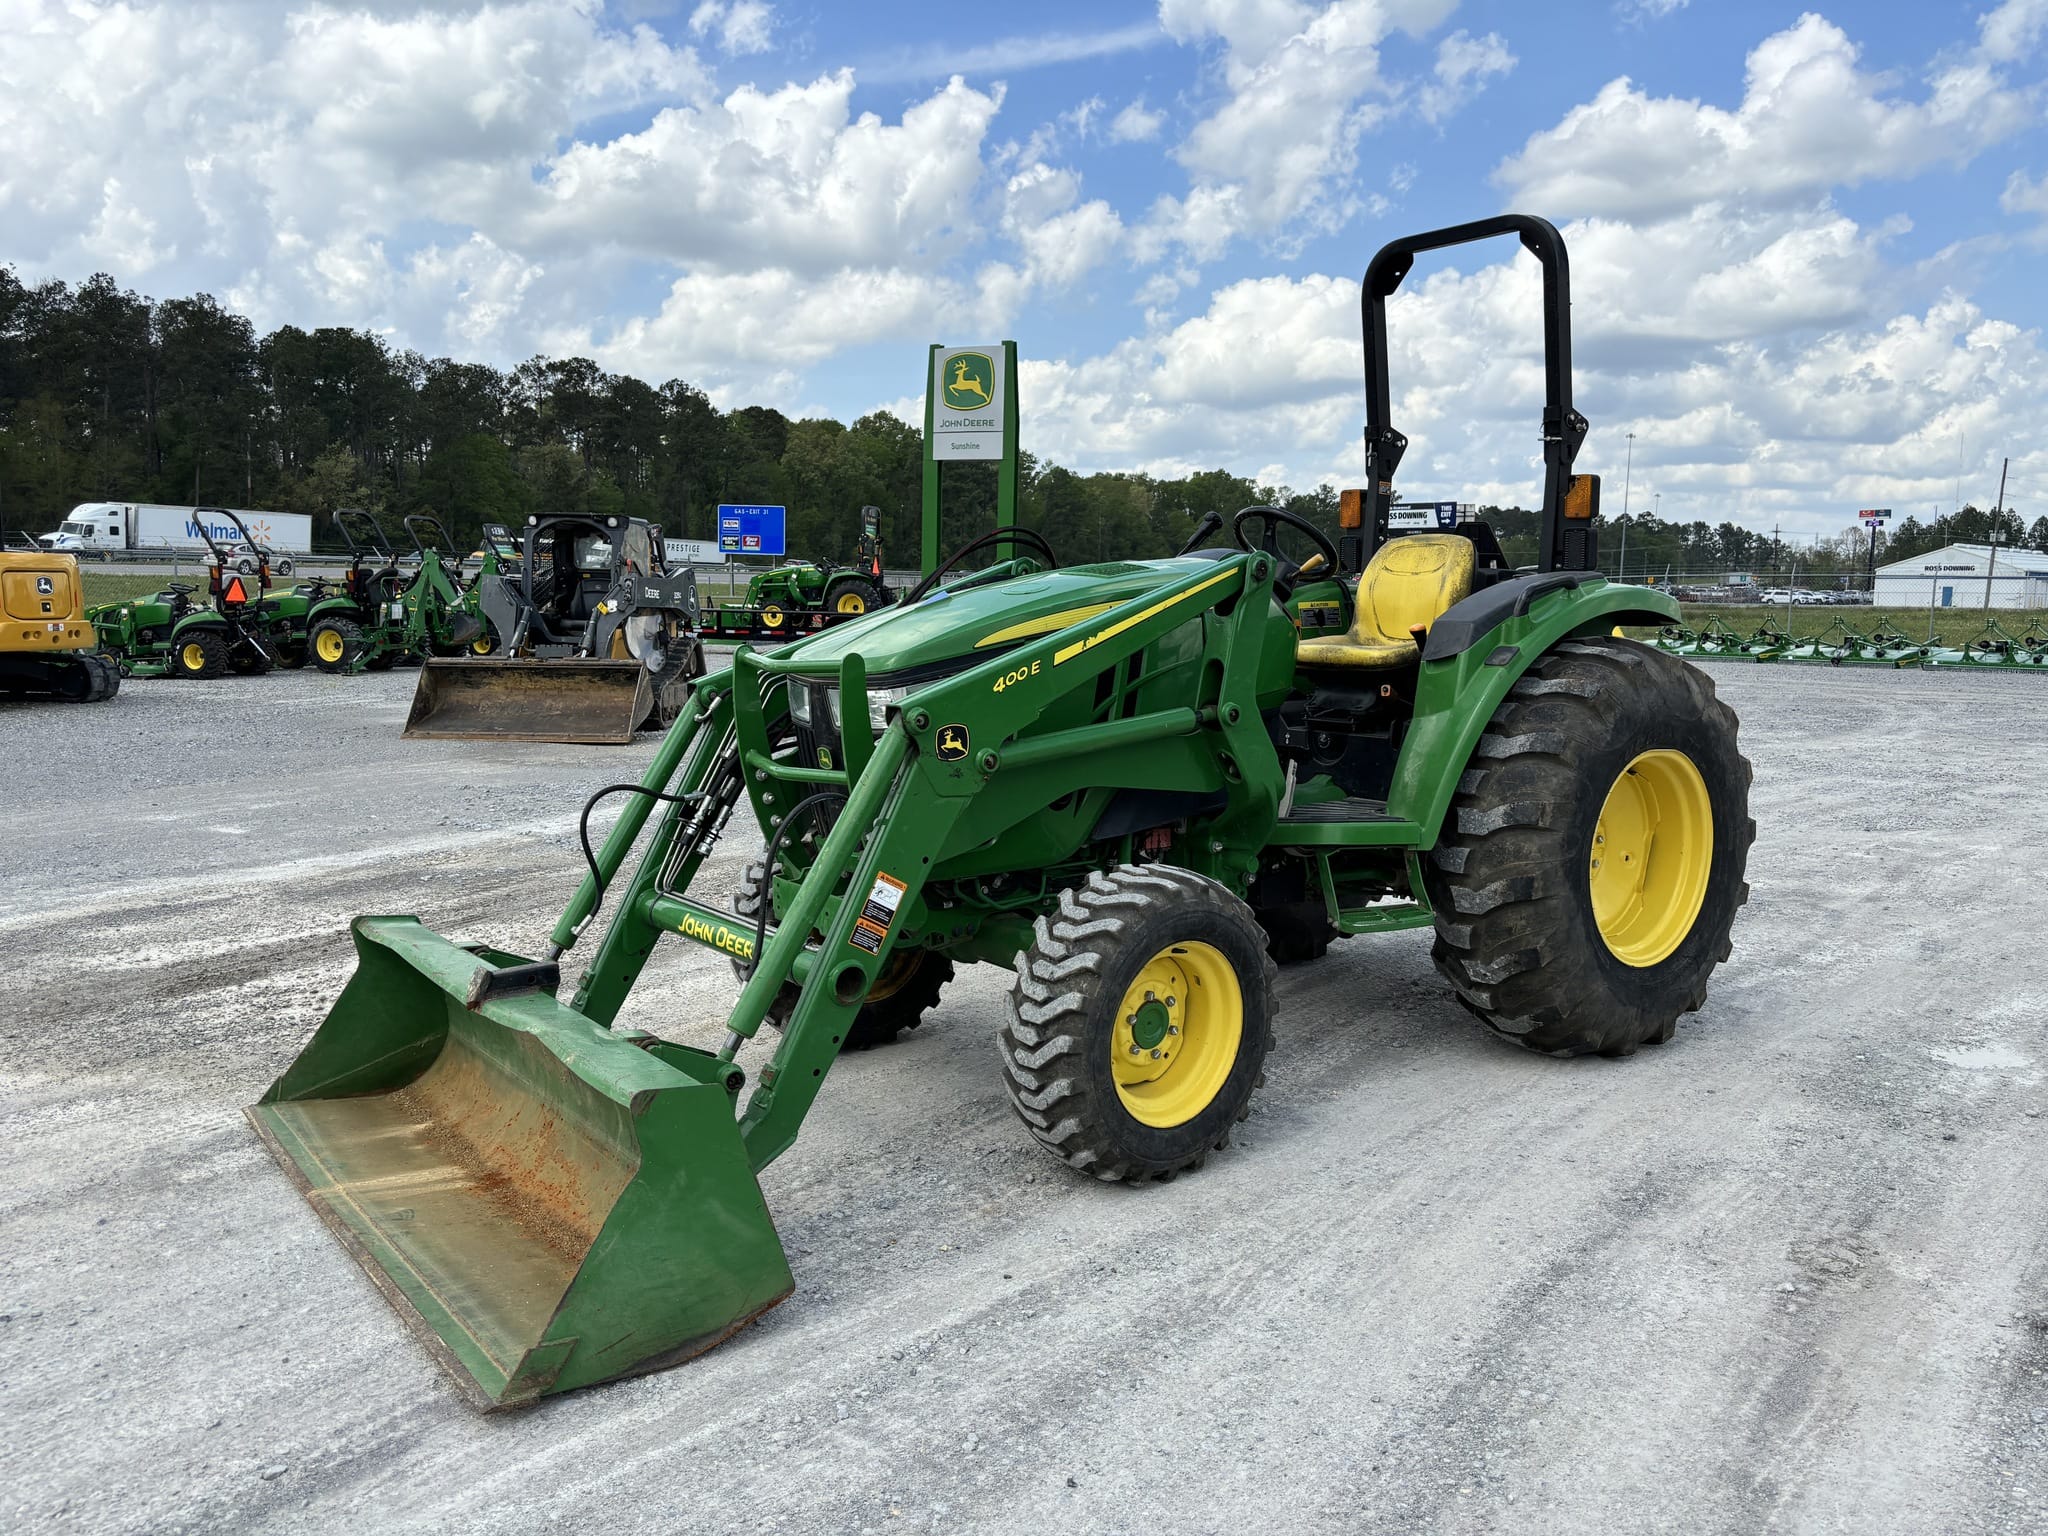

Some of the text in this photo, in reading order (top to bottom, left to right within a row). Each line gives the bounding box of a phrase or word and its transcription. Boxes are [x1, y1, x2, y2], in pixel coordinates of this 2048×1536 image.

[940, 418, 995, 428] JOHN DEERE
[951, 442, 980, 450] Sunshine
[1398, 511, 1428, 519] DOWNING
[667, 543, 700, 553] PRESTIGE
[645, 586, 660, 599] DEERE
[678, 913, 754, 960] JOHN DEER
